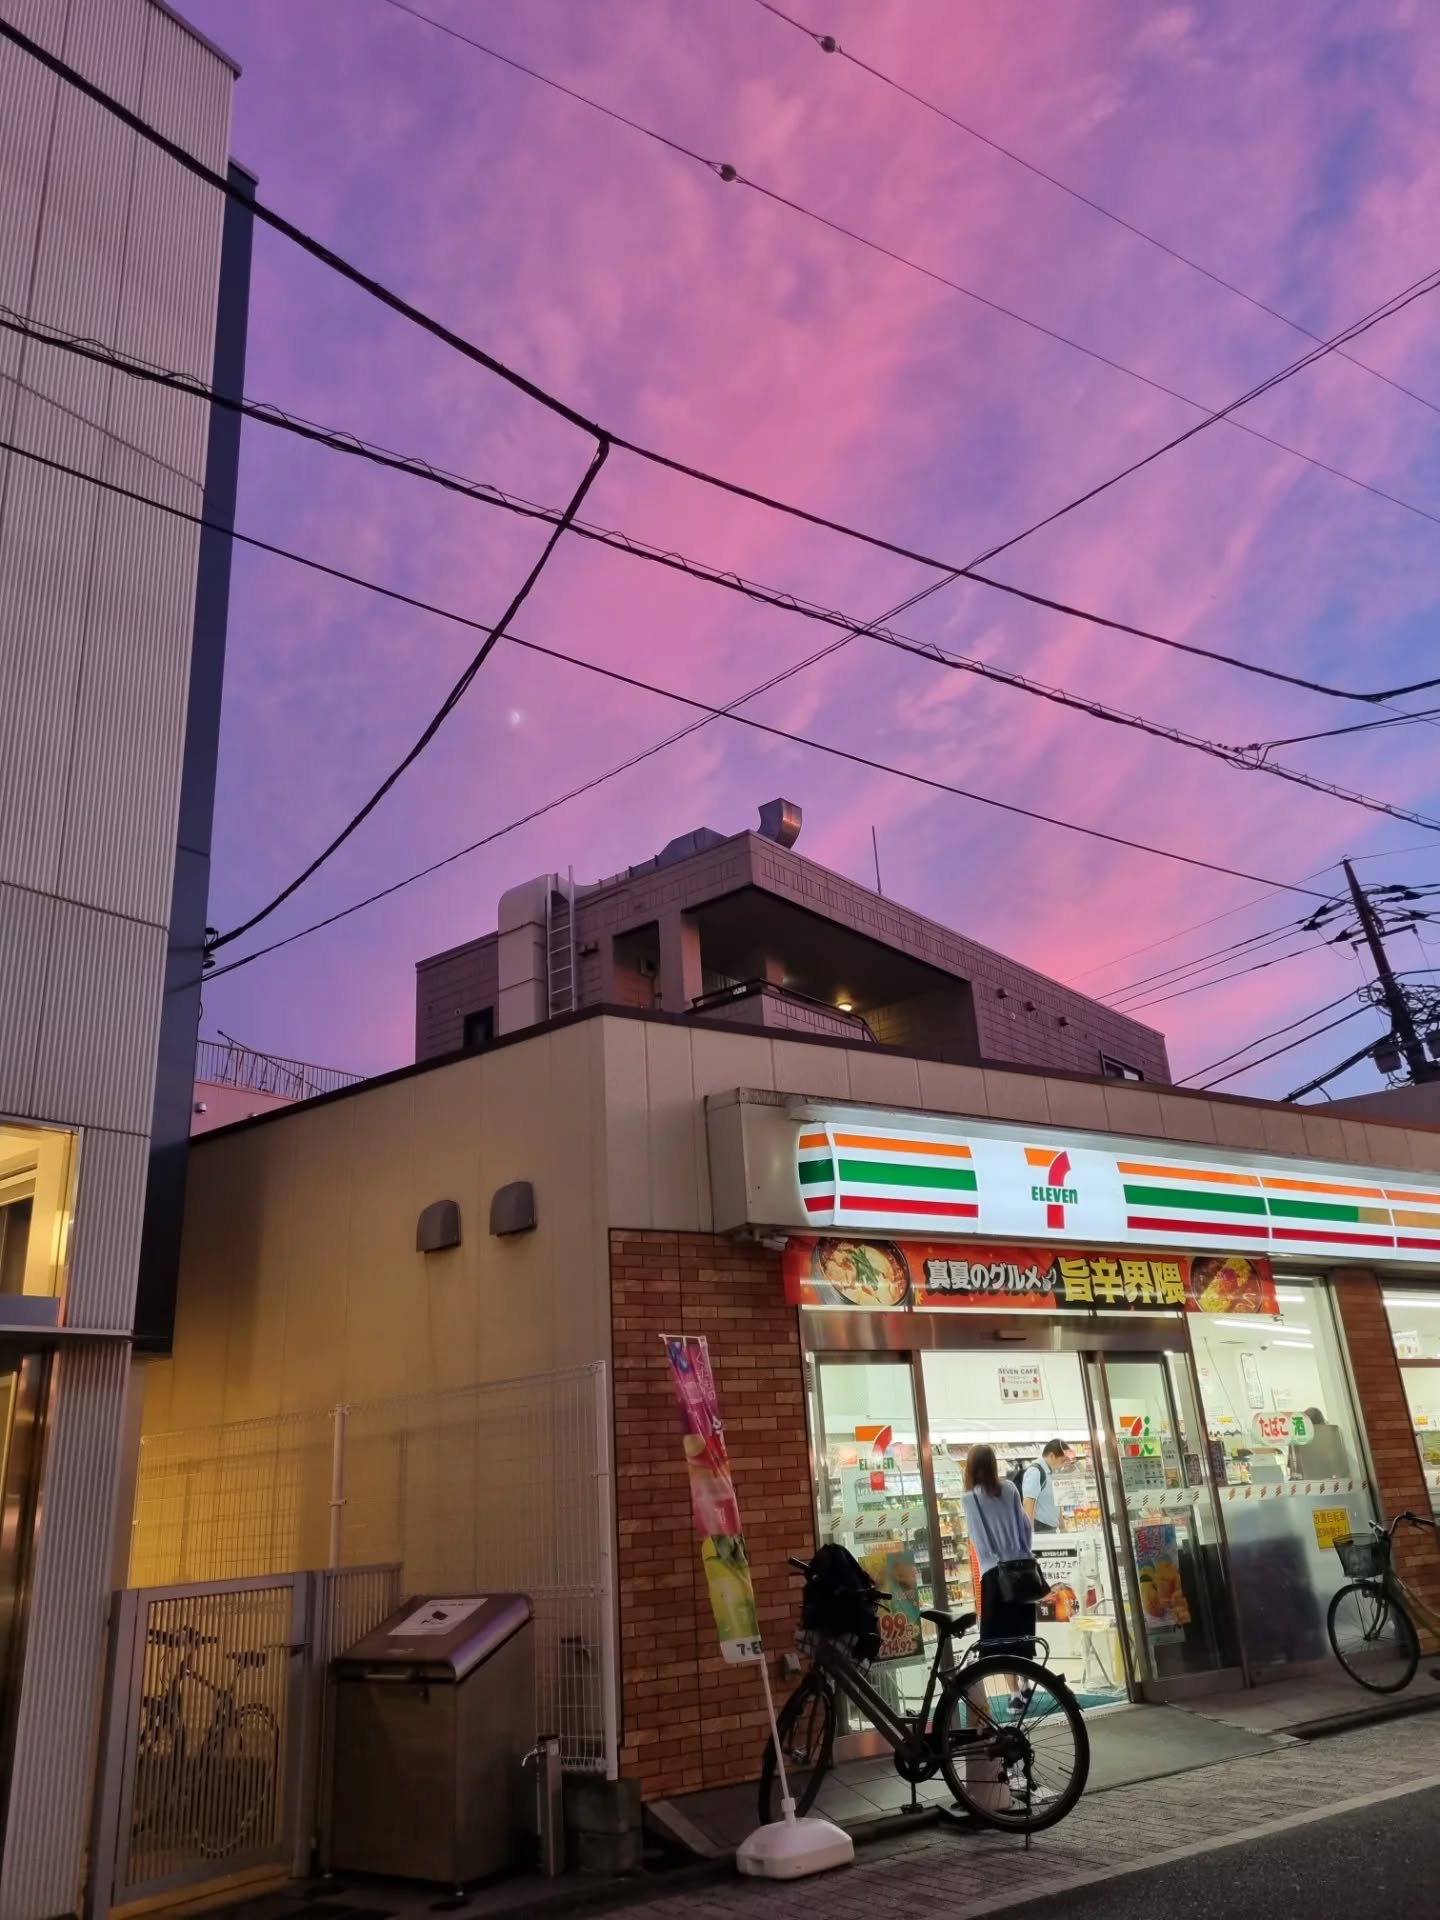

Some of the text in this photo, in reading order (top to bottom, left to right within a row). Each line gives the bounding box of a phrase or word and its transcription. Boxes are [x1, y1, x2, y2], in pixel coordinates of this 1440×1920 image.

[1056, 1256, 1186, 1304] 旨辛界隈
[1259, 1416, 1306, 1437] たばこ 酒
